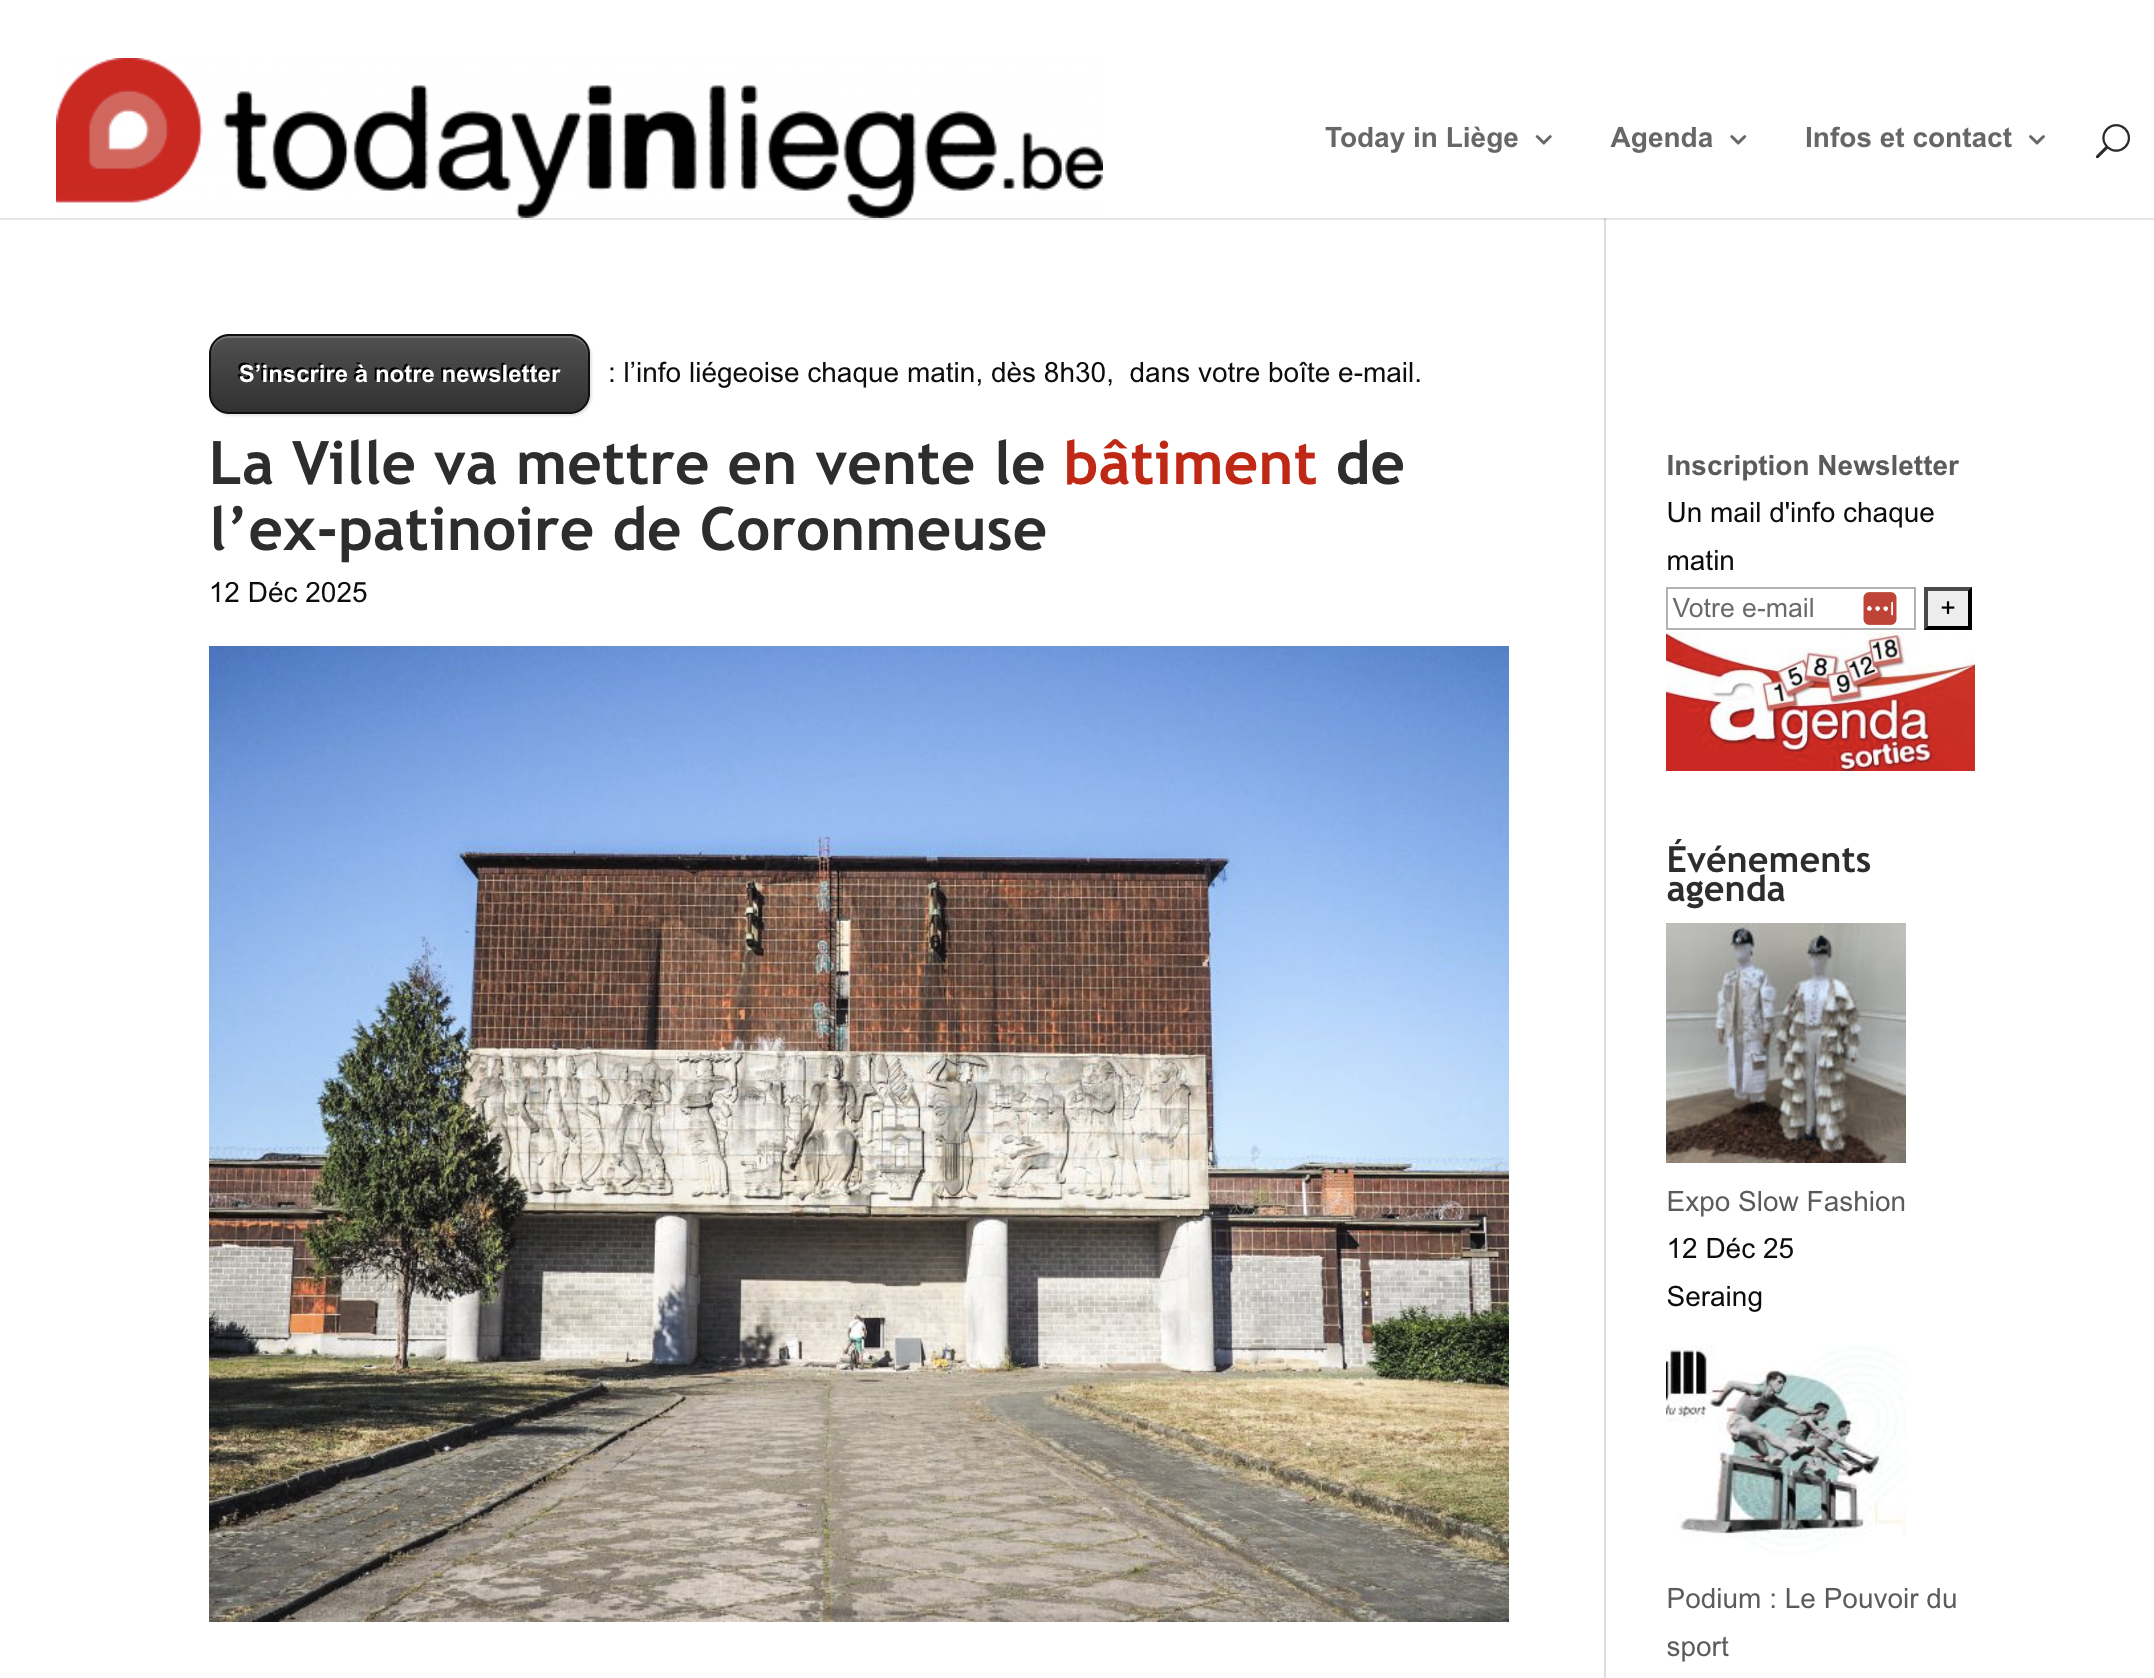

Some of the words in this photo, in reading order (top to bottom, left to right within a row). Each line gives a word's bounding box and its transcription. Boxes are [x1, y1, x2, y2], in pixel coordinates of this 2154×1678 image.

[1325, 126, 1406, 154] Today
[1414, 126, 1437, 148] in
[1447, 126, 1519, 154] Liège
[1610, 126, 1713, 154] Agenda
[1806, 126, 1872, 148] Infos
[1880, 127, 1905, 148] et
[1913, 127, 2013, 148] contact
[224, 85, 1104, 218] todayinliege.be
[239, 364, 348, 383] S’inscrire
[355, 364, 368, 383] à
[376, 365, 435, 383] notre
[442, 364, 561, 383] newsletter
[609, 366, 615, 383] :
[624, 361, 681, 384] l’info
[690, 361, 800, 389] liégeoise
[807, 361, 899, 389] chaque
[908, 361, 982, 387] matin,
[991, 361, 1036, 384] dès
[1044, 361, 1113, 387] 8h30,
[1129, 361, 1190, 384] dans
[1197, 362, 1260, 384] votre
[1269, 361, 1330, 384] boîte
[1338, 361, 1421, 384] e-mail.
[212, 440, 274, 486] La
[291, 438, 415, 486] Ville
[433, 451, 497, 486] va
[518, 443, 709, 486] mettre
[728, 451, 795, 486] en
[815, 443, 975, 486] vente
[998, 438, 1045, 486] le
[1066, 438, 1317, 486] bâtiment
[1337, 438, 1404, 486] de
[1667, 454, 1809, 482] Inscription
[1818, 454, 1960, 476] Newsletter
[1667, 501, 1702, 524] Un
[1711, 501, 1761, 524] mail
[1769, 501, 1836, 524] d'info
[1843, 501, 1935, 529] chaque
[213, 504, 594, 564] l’ex-patinoire
[614, 504, 681, 552] de
[701, 505, 1047, 552] Coronmeuse
[1667, 549, 1734, 572] matin
[211, 581, 240, 603] 12
[249, 581, 298, 604] Déc
[305, 581, 368, 604] 2025
[1672, 597, 1735, 618] Votre
[1742, 597, 1814, 618] e-mail
[1872, 639, 1899, 660] 18
[1787, 666, 1804, 686] 5
[1813, 657, 1828, 677] 8
[1849, 655, 1876, 679] 12
[1774, 683, 1785, 702] 1
[1836, 674, 1851, 694] 9
[1709, 669, 1929, 750] agenda
[1840, 742, 1931, 770] sorties
[1668, 838, 1871, 873] Événements
[1666, 867, 1786, 909] agenda
[1668, 1190, 1730, 1218] Expo
[1738, 1190, 1799, 1212] Slow
[1808, 1190, 1905, 1212] Fashion
[1668, 1237, 1697, 1259] 12
[1706, 1237, 1756, 1260] Déc
[1763, 1237, 1794, 1260] 25
[1667, 1284, 1762, 1313] Seraing
[1678, 1405, 1706, 1417] sport
[1668, 1587, 1761, 1609] Podium
[1786, 1587, 1816, 1609] Le
[1825, 1587, 1920, 1609] Pouvoir
[1926, 1587, 1957, 1609] du
[1667, 1636, 1730, 1663] sport
